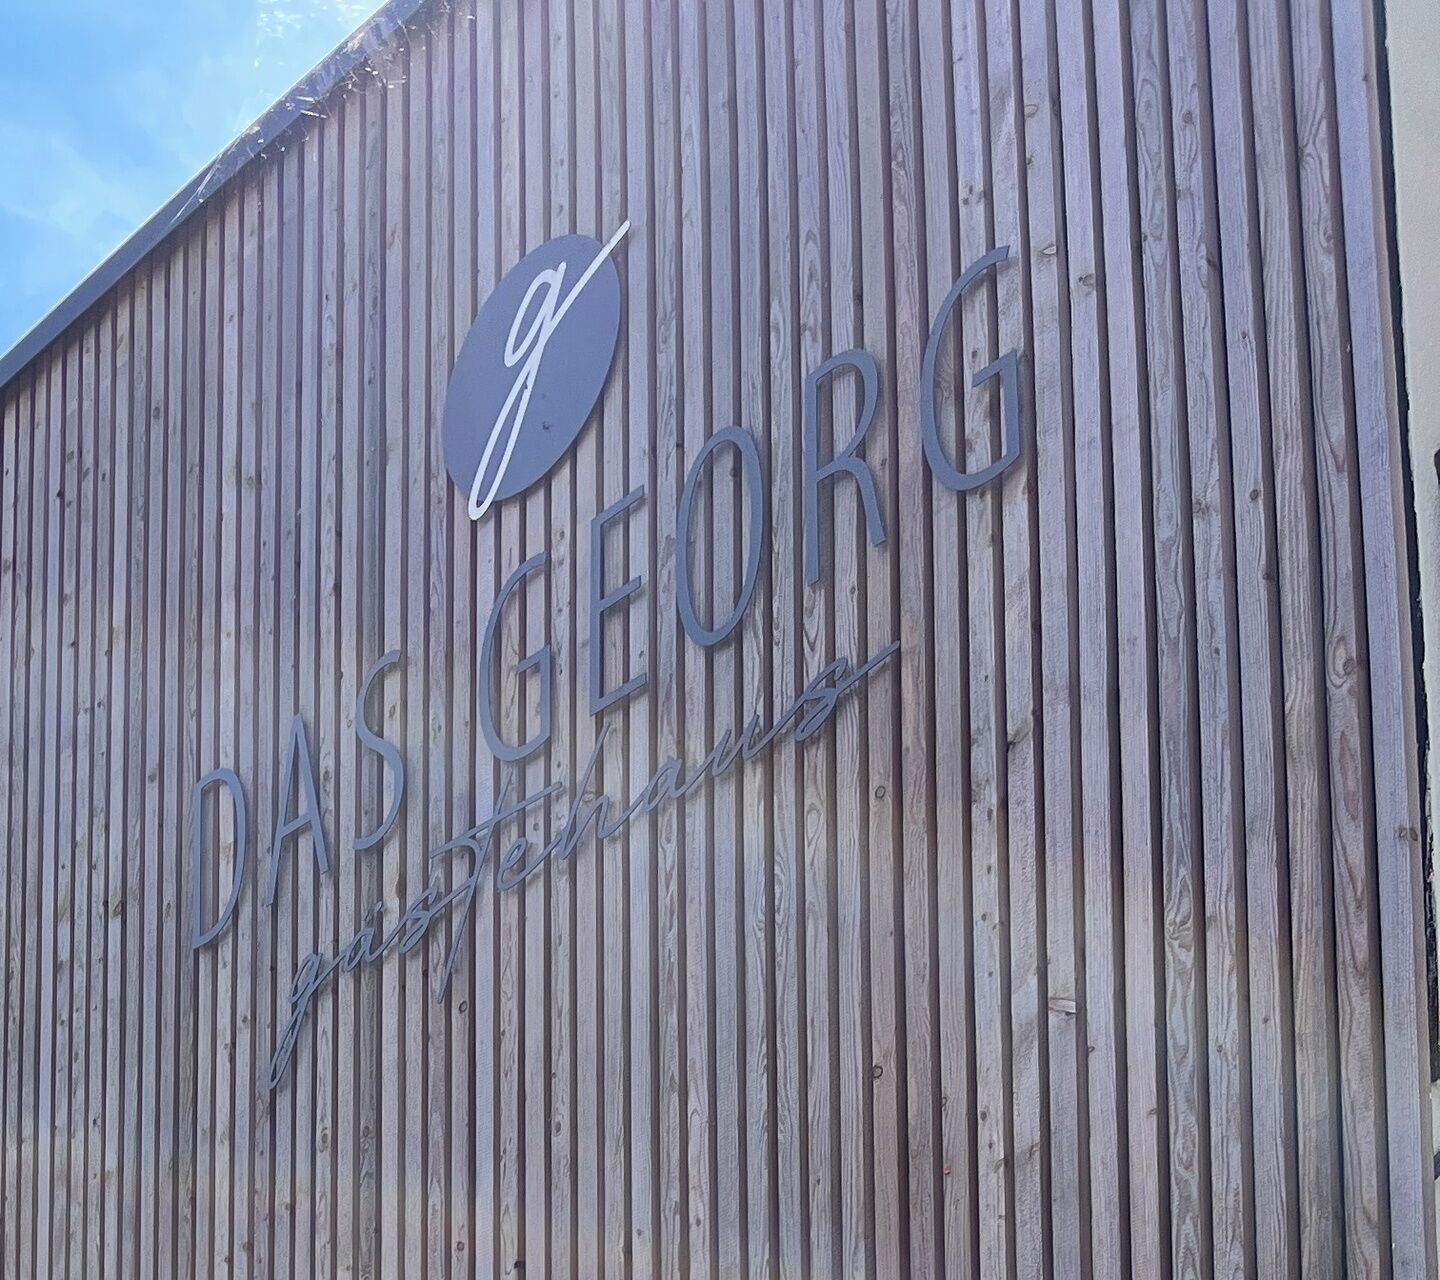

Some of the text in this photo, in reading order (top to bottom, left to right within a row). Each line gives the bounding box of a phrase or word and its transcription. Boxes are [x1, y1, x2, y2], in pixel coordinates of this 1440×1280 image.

[468, 220, 630, 521] g
[190, 245, 1023, 951] DAS GEORG
[268, 640, 902, 1092] gästehaus
